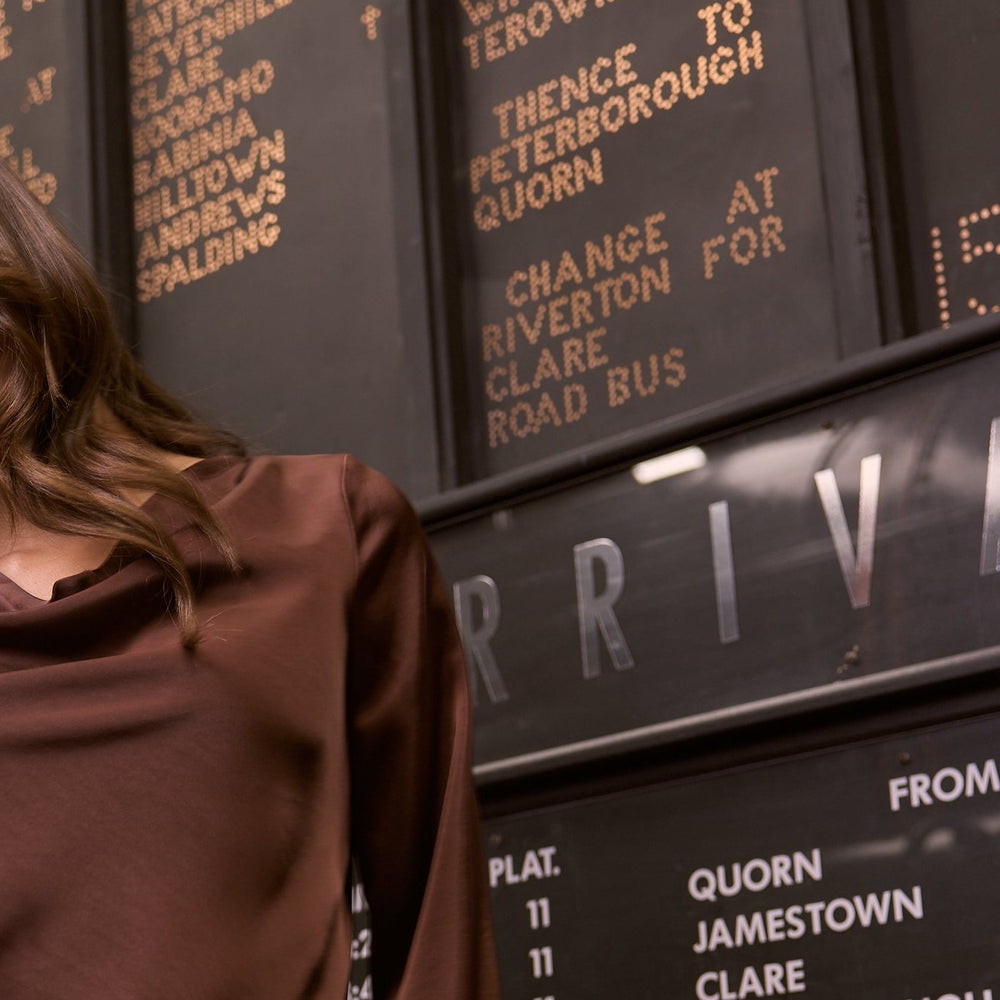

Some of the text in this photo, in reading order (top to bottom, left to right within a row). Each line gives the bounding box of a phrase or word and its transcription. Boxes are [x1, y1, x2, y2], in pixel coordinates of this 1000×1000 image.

[131, 46, 223, 119] CLARE
[470, 30, 764, 194] PETERBOROUGH
[493, 0, 753, 140] THENCE TO
[134, 129, 285, 232] HILLTOWN
[136, 170, 286, 268] ANDREWS
[473, 148, 603, 232] QUORN
[136, 212, 281, 303] SPALDING
[506, 166, 779, 307] CHANGE AT
[482, 215, 786, 362] RIVERTON FOR
[485, 326, 609, 402] CLARE
[488, 347, 687, 448] ROAD BUS
[888, 759, 1000, 811] FROM
[489, 846, 561, 888] PLAT.
[688, 848, 823, 902] QUORN
[526, 898, 551, 930] 11
[693, 886, 924, 954] JAMESTOWN
[528, 946, 553, 980] 11
